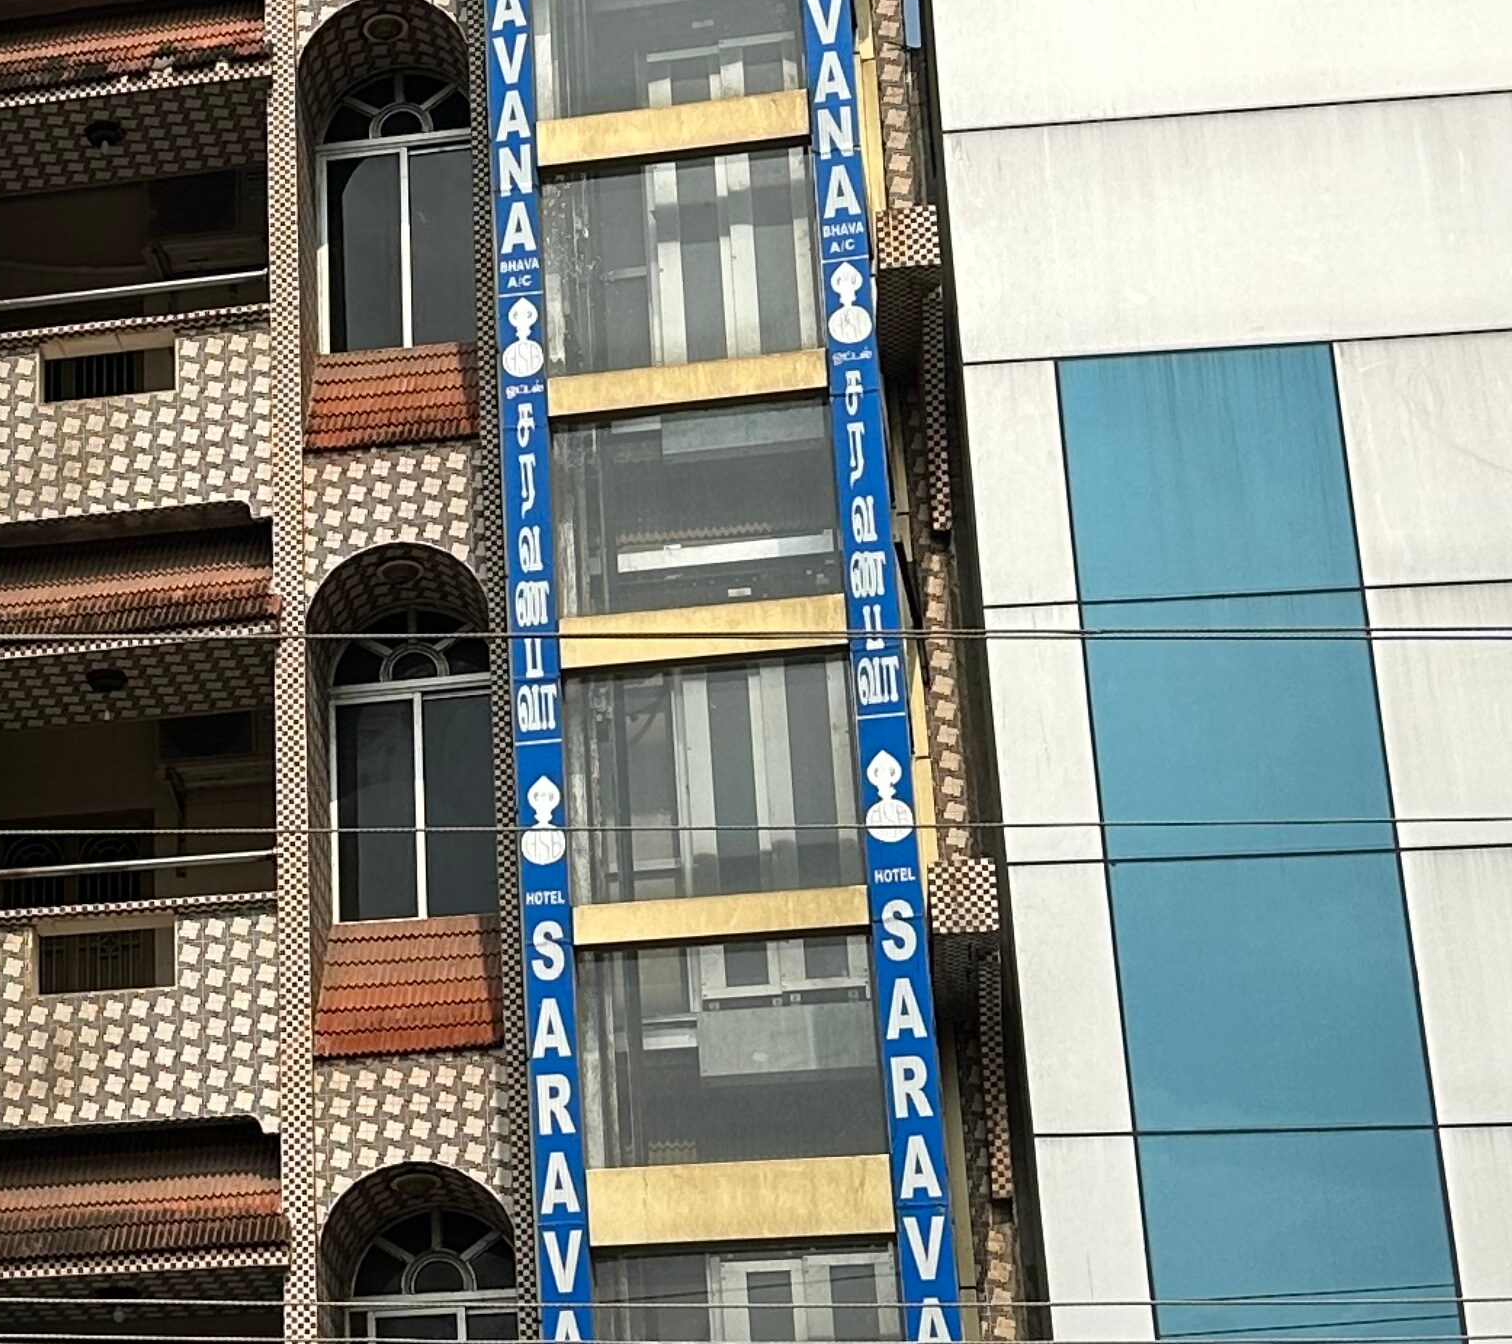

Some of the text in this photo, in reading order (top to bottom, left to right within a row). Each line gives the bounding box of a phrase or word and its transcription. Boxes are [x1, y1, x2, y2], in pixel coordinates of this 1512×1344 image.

[823, 221, 865, 239] BHAVA
[830, 238, 856, 254] A/C
[500, 257, 540, 274] BHAVA
[507, 274, 533, 288] A/C
[874, 867, 916, 883] HOTEL
[526, 890, 565, 906] HOTEL
